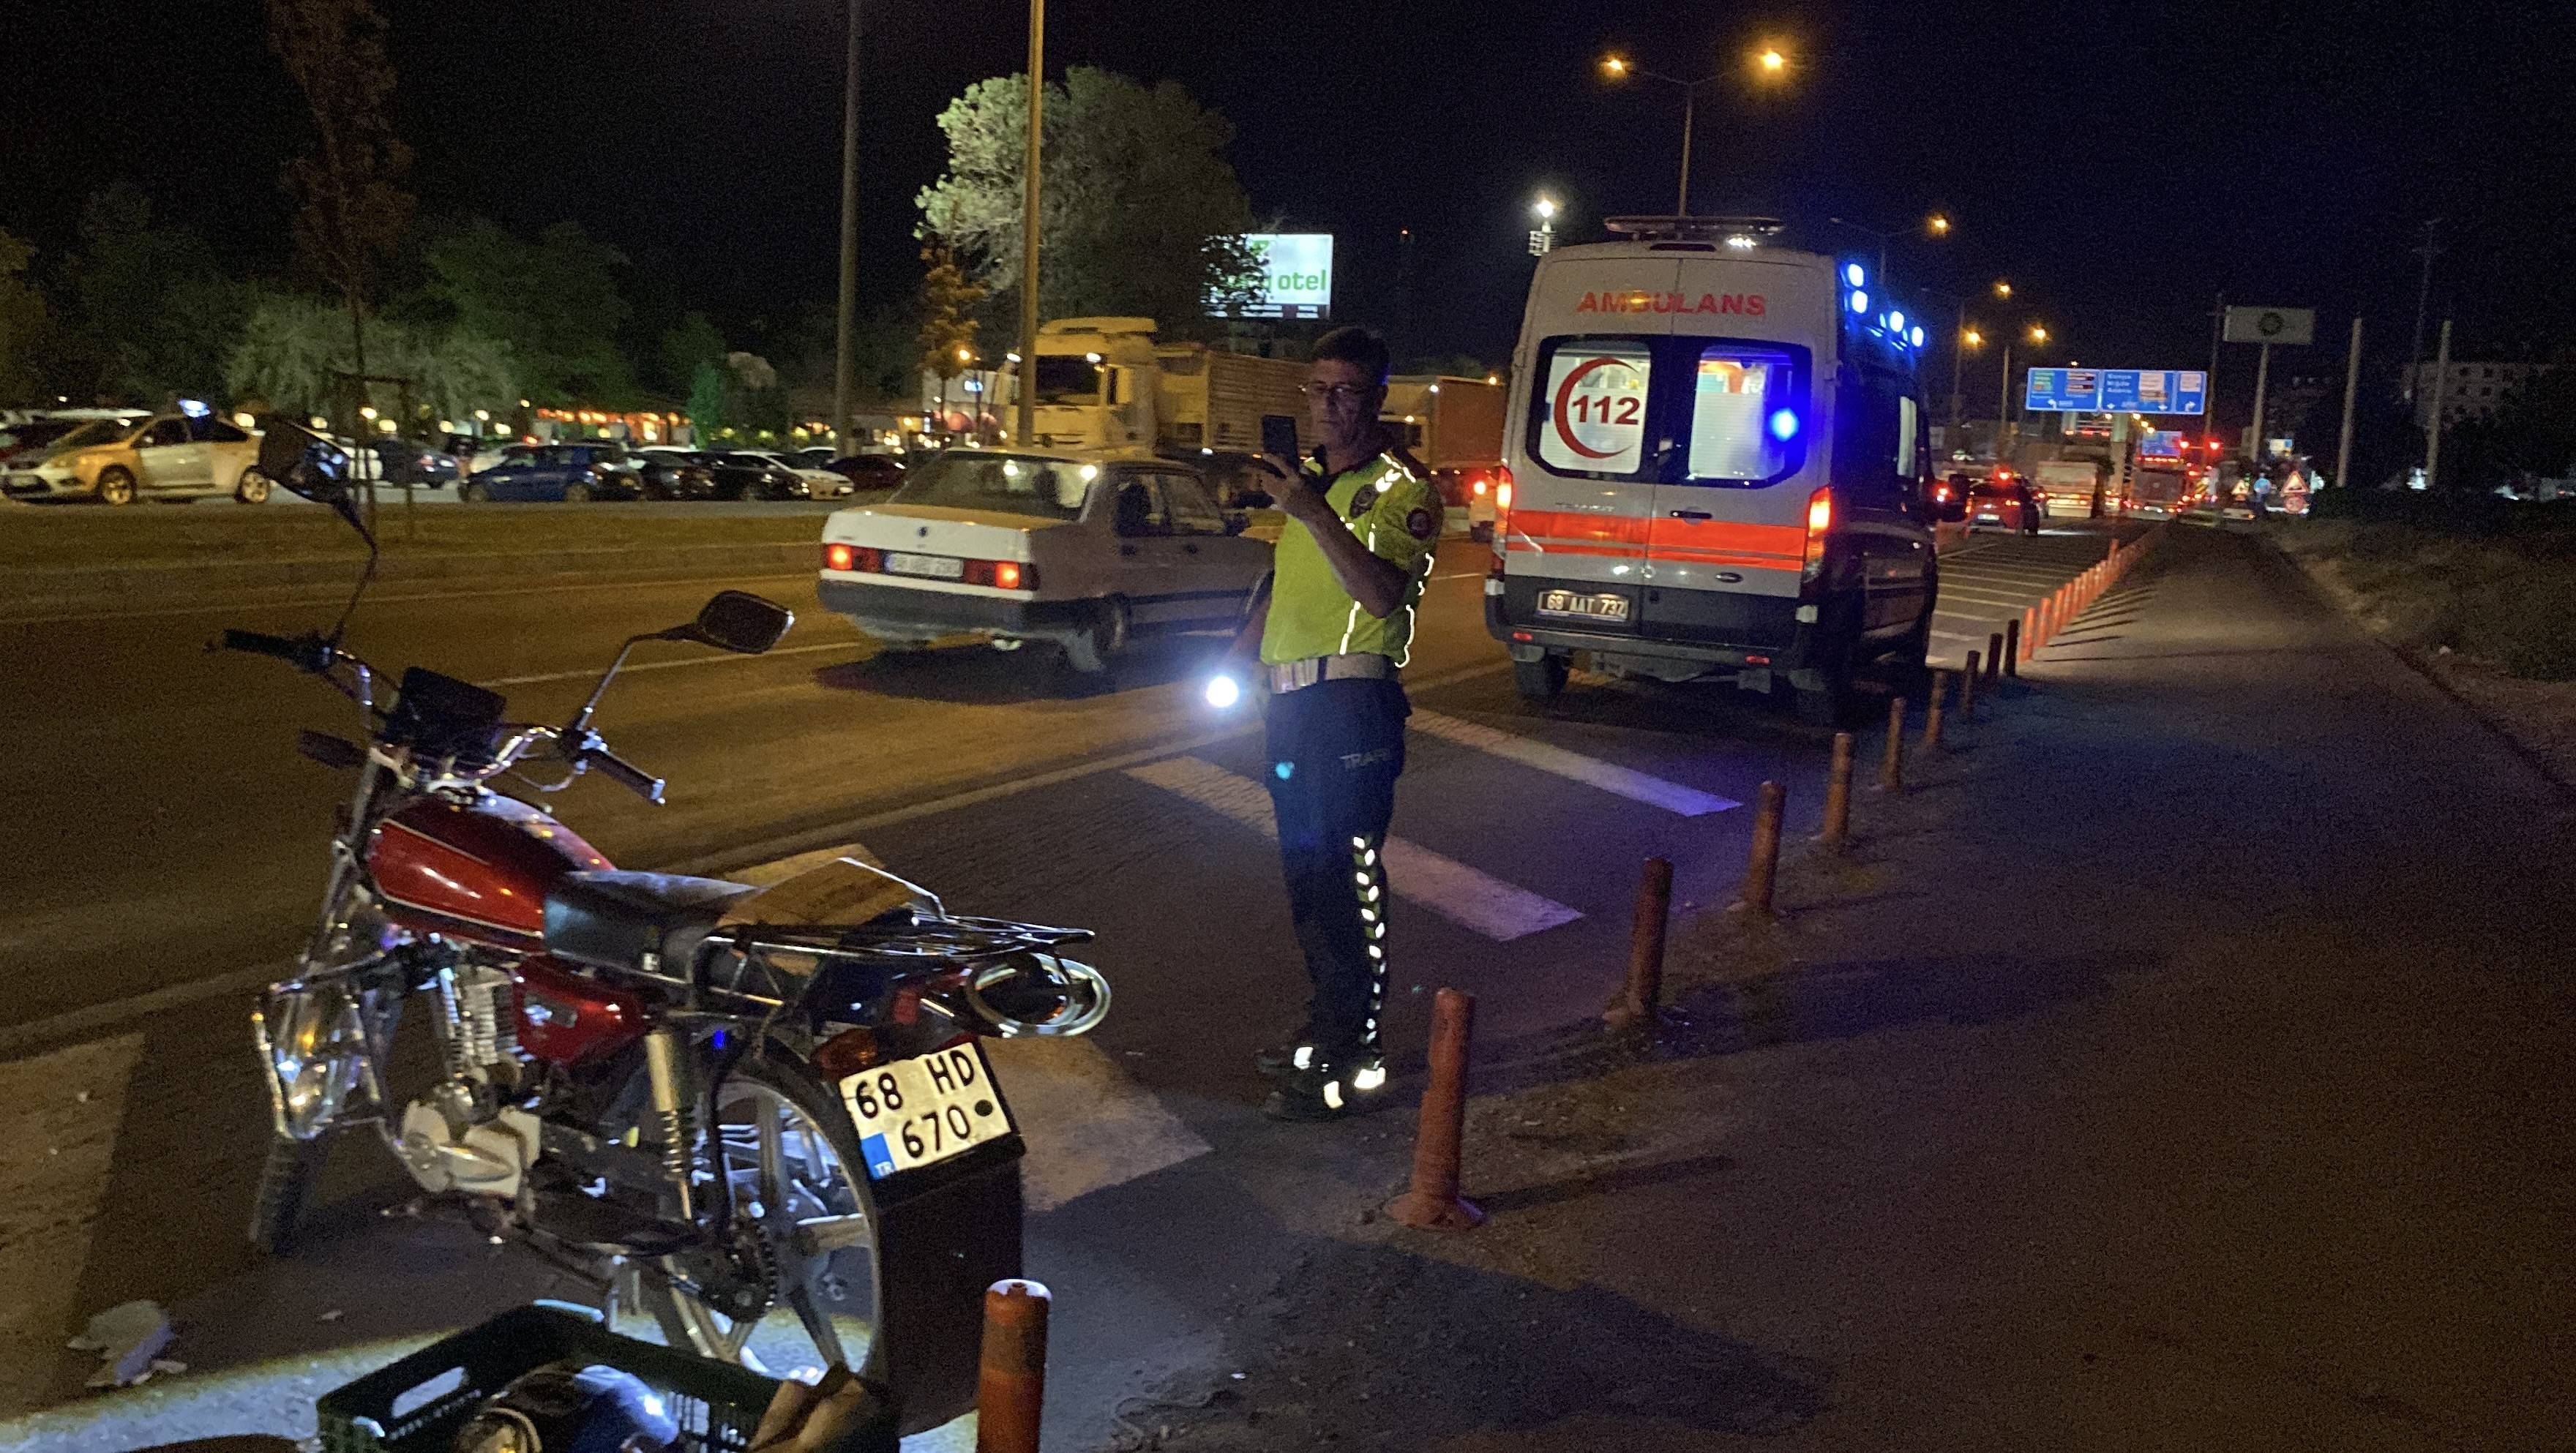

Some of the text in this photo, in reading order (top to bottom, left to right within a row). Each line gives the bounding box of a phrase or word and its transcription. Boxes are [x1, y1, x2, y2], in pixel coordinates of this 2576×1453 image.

[1576, 291, 1767, 316] AMBULANS
[1572, 394, 1641, 425] 112
[1547, 594, 1565, 610] 68
[1568, 596, 1595, 613] AAT
[855, 1050, 975, 1119] 68 HD
[902, 1105, 970, 1158] 670
[874, 1160, 895, 1177] TR
